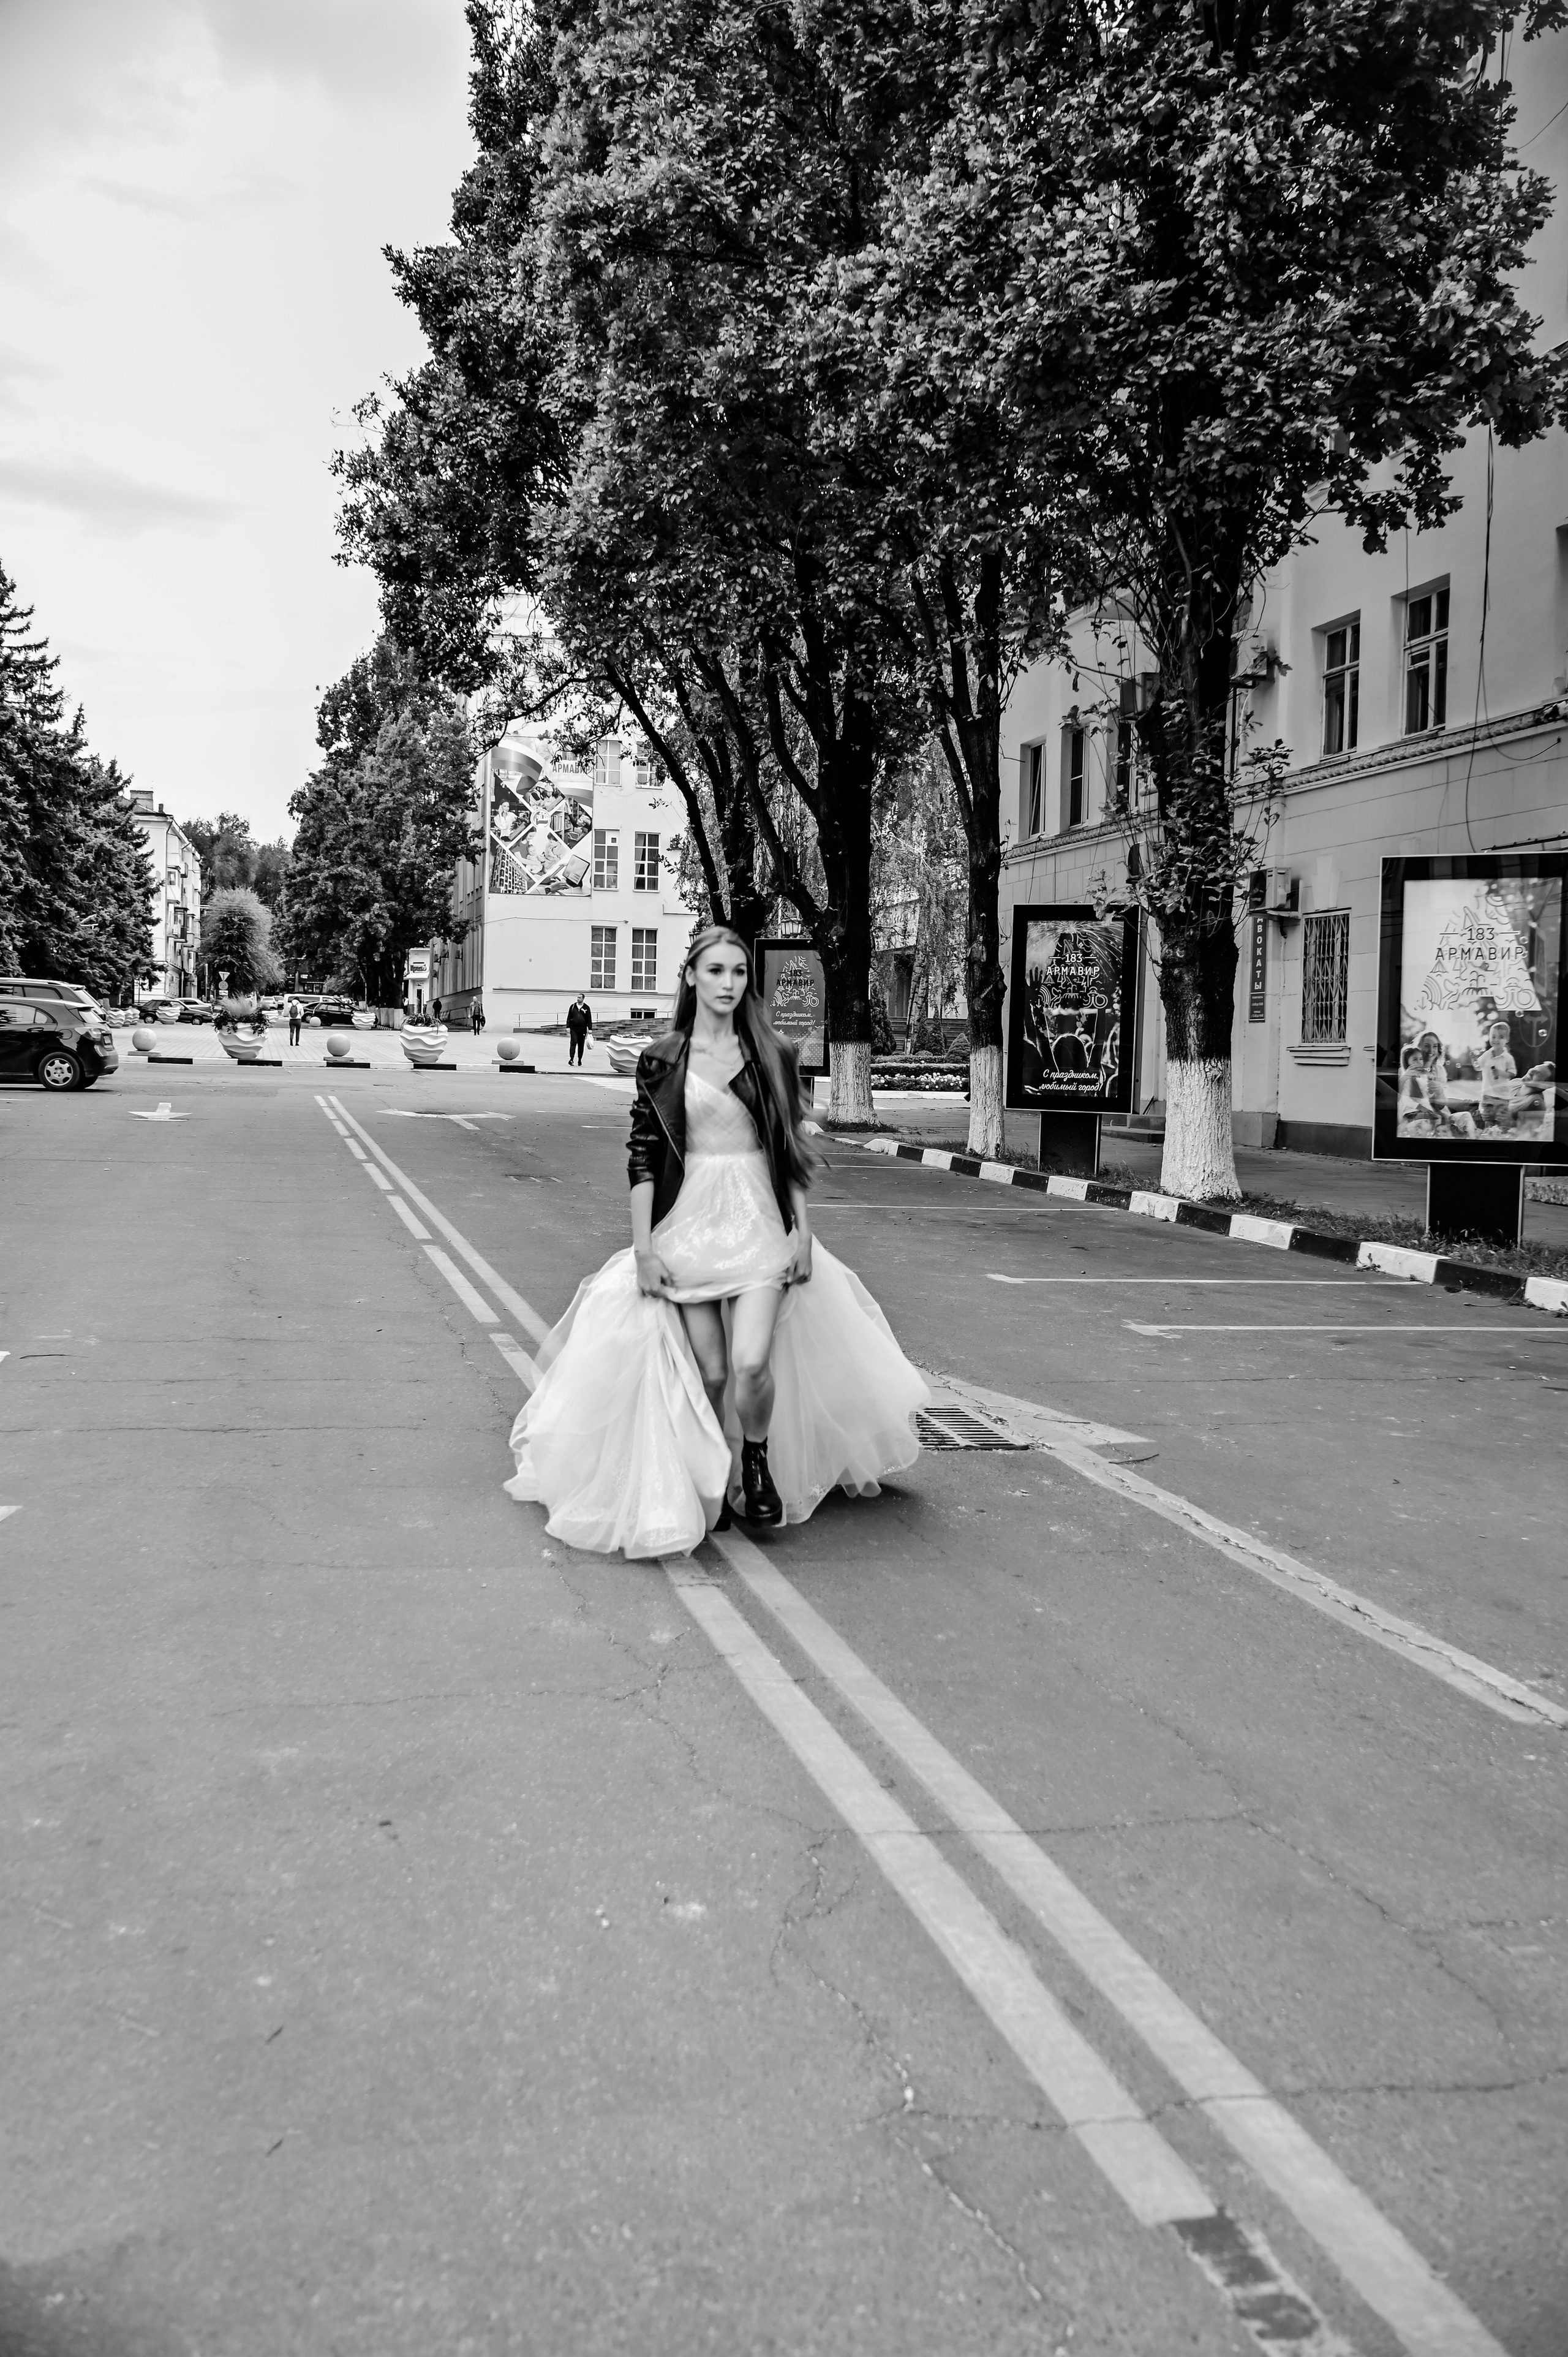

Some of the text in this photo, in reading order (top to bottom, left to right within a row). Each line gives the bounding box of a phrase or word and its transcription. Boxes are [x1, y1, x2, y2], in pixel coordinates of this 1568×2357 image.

[1467, 927, 1495, 940] 183
[1065, 953, 1083, 963] 183
[1254, 918, 1264, 990] ДВОКАТЫ
[1435, 947, 1524, 961] АРМАВИР
[1046, 966, 1100, 976] АРМАВИР
[1043, 1069, 1050, 1078] С
[1039, 1081, 1103, 1094] любимый город!
